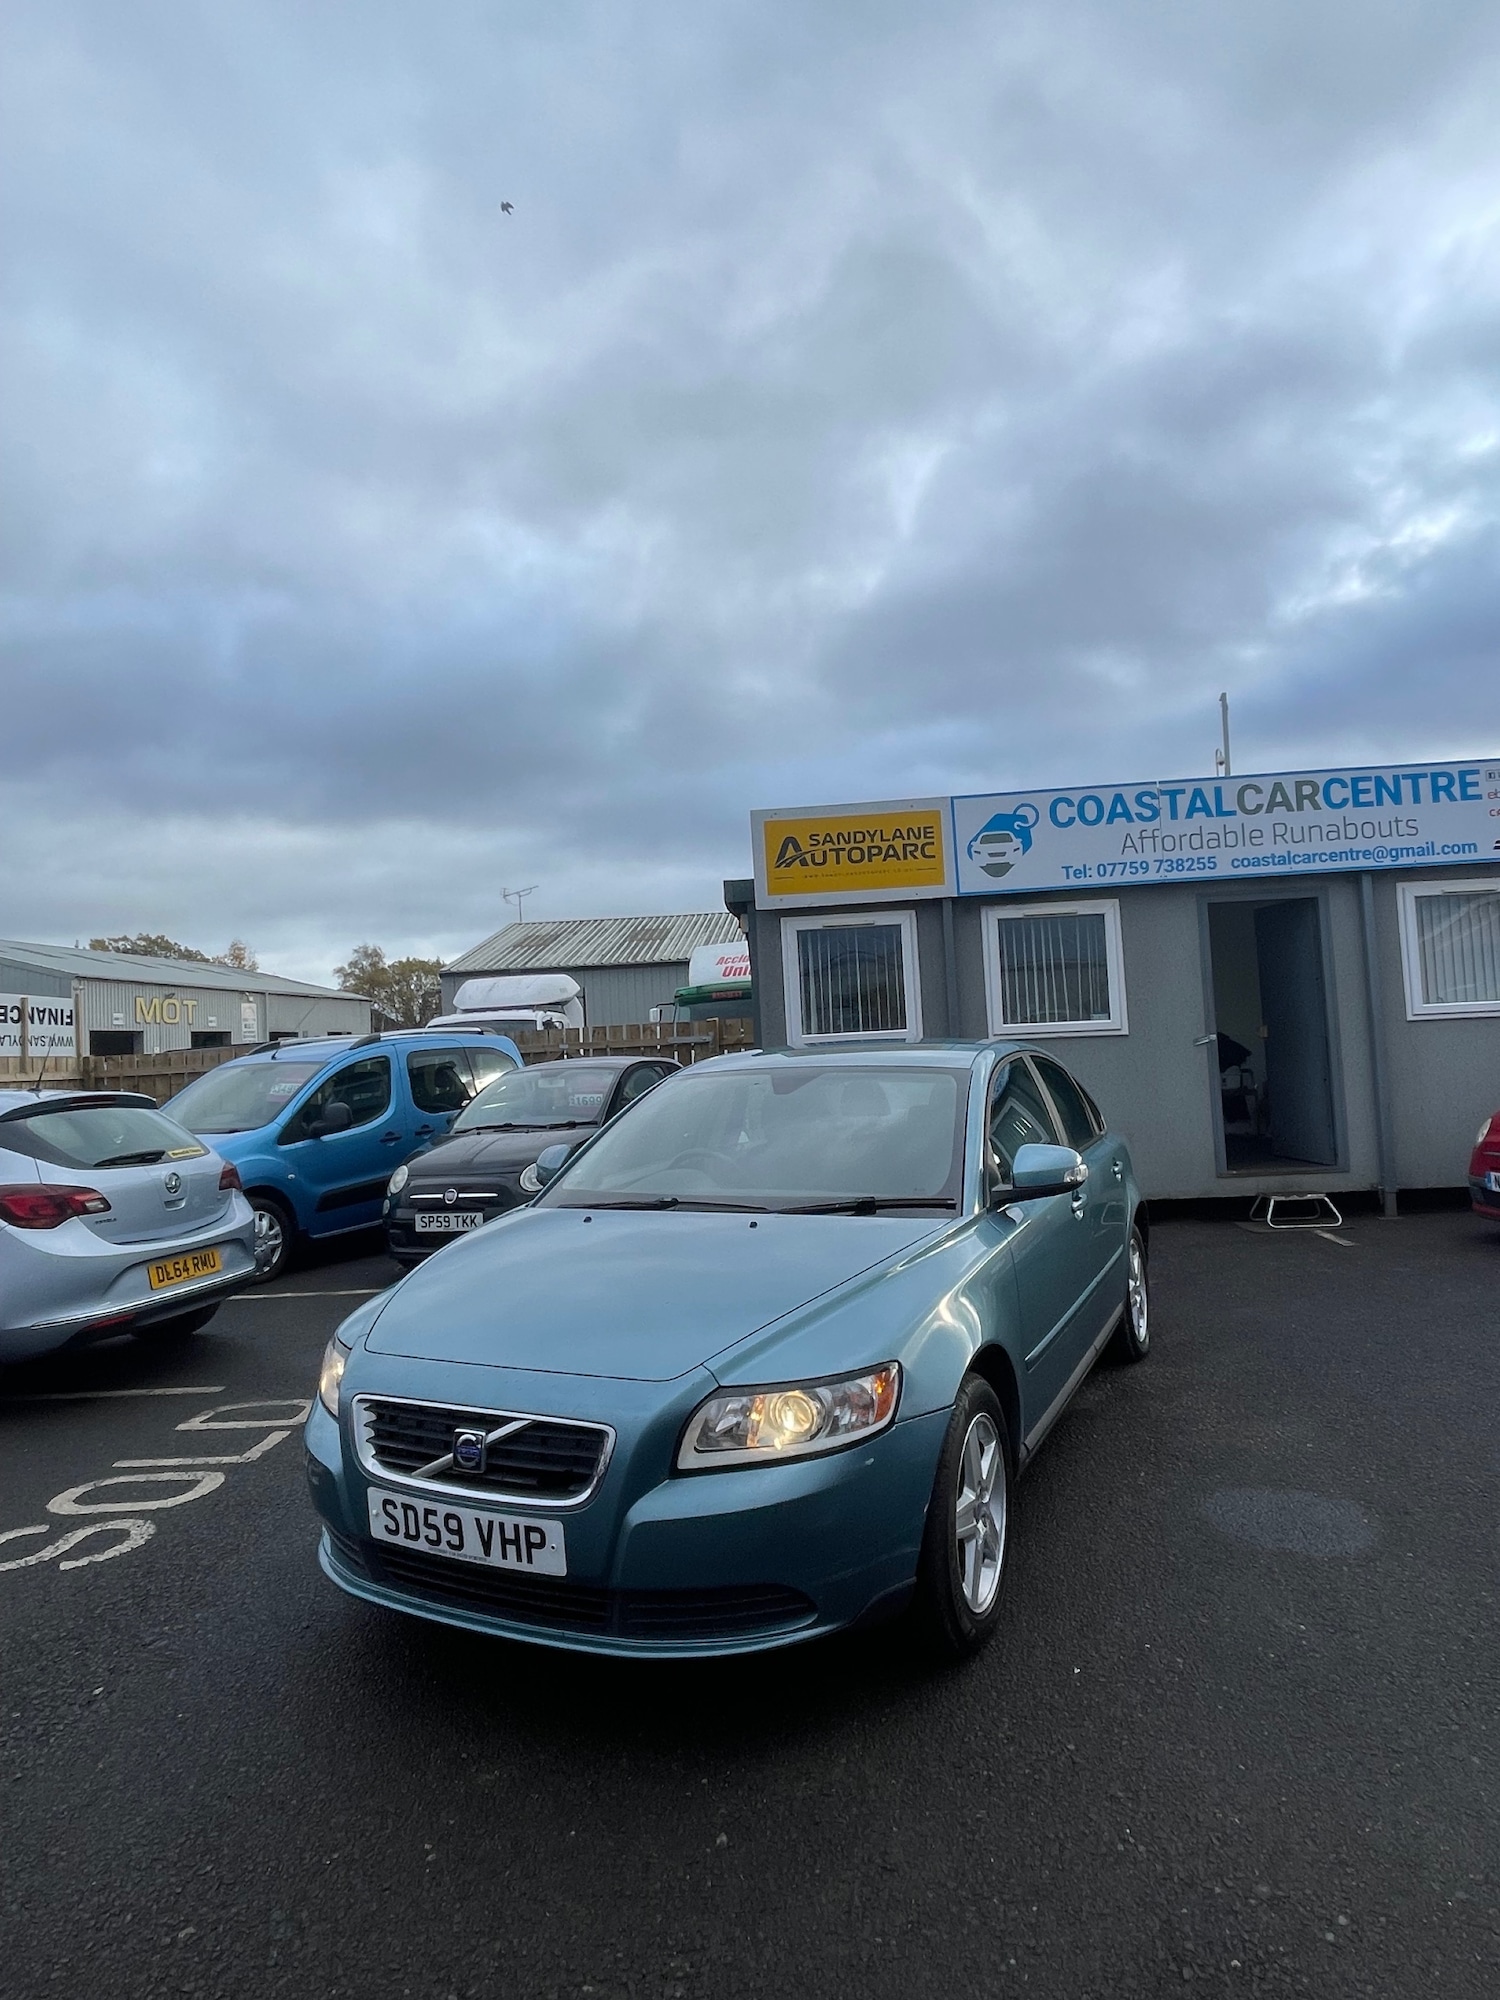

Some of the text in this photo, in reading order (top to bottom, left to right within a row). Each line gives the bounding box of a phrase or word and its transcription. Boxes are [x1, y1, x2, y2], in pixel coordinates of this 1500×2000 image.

[1049, 769, 1483, 829] COASTALCARCENTRE
[774, 836, 936, 868] AUTOPARC
[809, 826, 935, 846] SANDYLANE
[1121, 817, 1419, 856] Affordable Runabouts
[1062, 841, 1477, 880] Tel: 07759 738255 coastalcarcentre@gmail.com
[135, 997, 197, 1025] MOT
[420, 1214, 478, 1228] SP59 TKK
[155, 1252, 216, 1284] DL64 RMU
[381, 1498, 547, 1565] SD59 VHP
